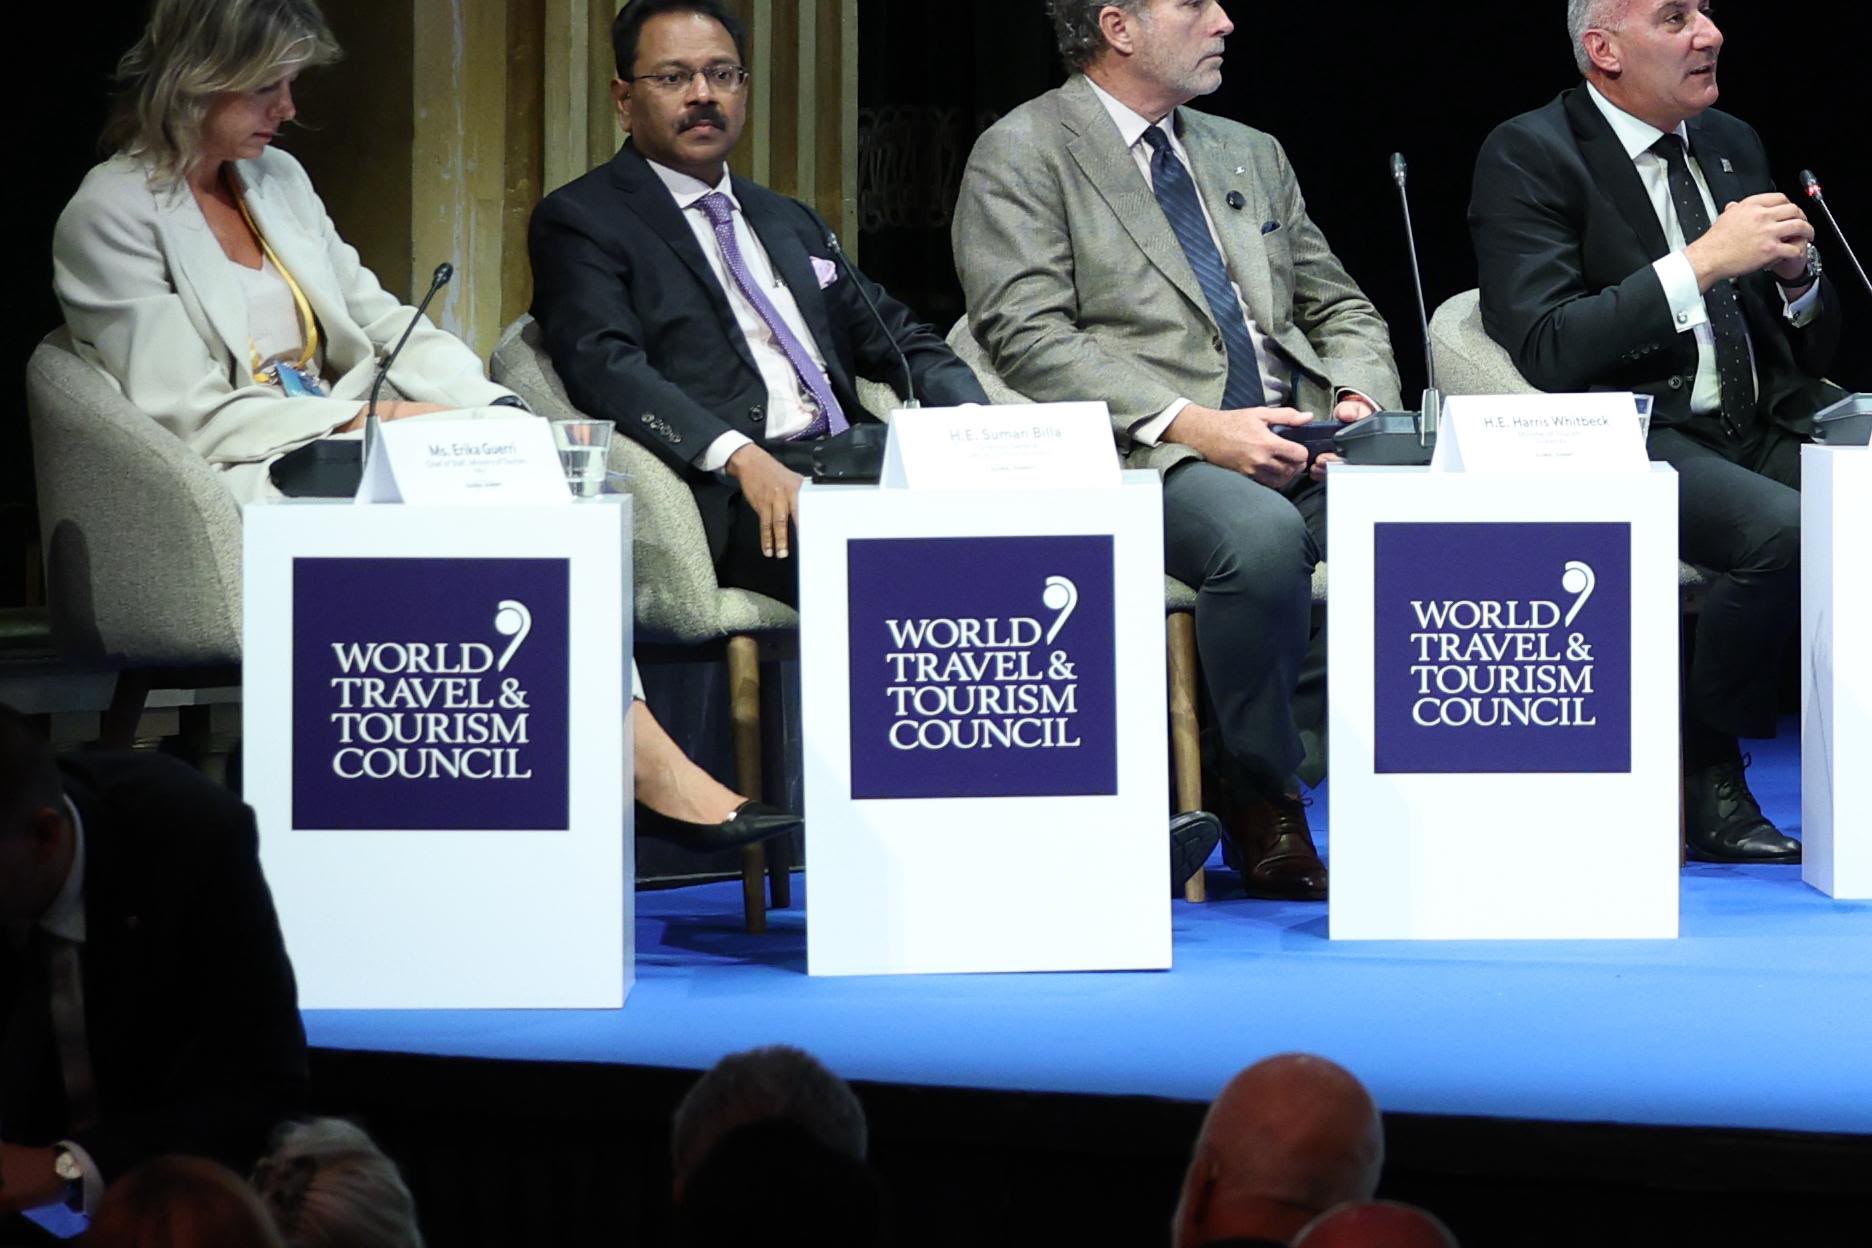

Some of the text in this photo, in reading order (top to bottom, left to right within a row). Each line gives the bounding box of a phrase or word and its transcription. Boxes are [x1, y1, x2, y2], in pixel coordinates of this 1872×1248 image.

[982, 429, 1028, 440] Suman
[1484, 416, 1609, 428] H.E. Harris Whitbeck
[1410, 600, 1560, 629] WORLD
[885, 617, 1042, 648] WORLD
[1410, 632, 1594, 661] TRAVEL &
[331, 642, 494, 673] WORLD
[886, 650, 1078, 682] TRAVEL &
[331, 677, 530, 708] TRAVEL &
[1410, 665, 1594, 694] TOURISM
[887, 684, 1078, 716] TOURISM
[1412, 698, 1596, 726] COUNCIL
[331, 713, 530, 744] TOURISM
[889, 718, 1080, 750] COUNCIL
[333, 748, 532, 778] COUNCIL
